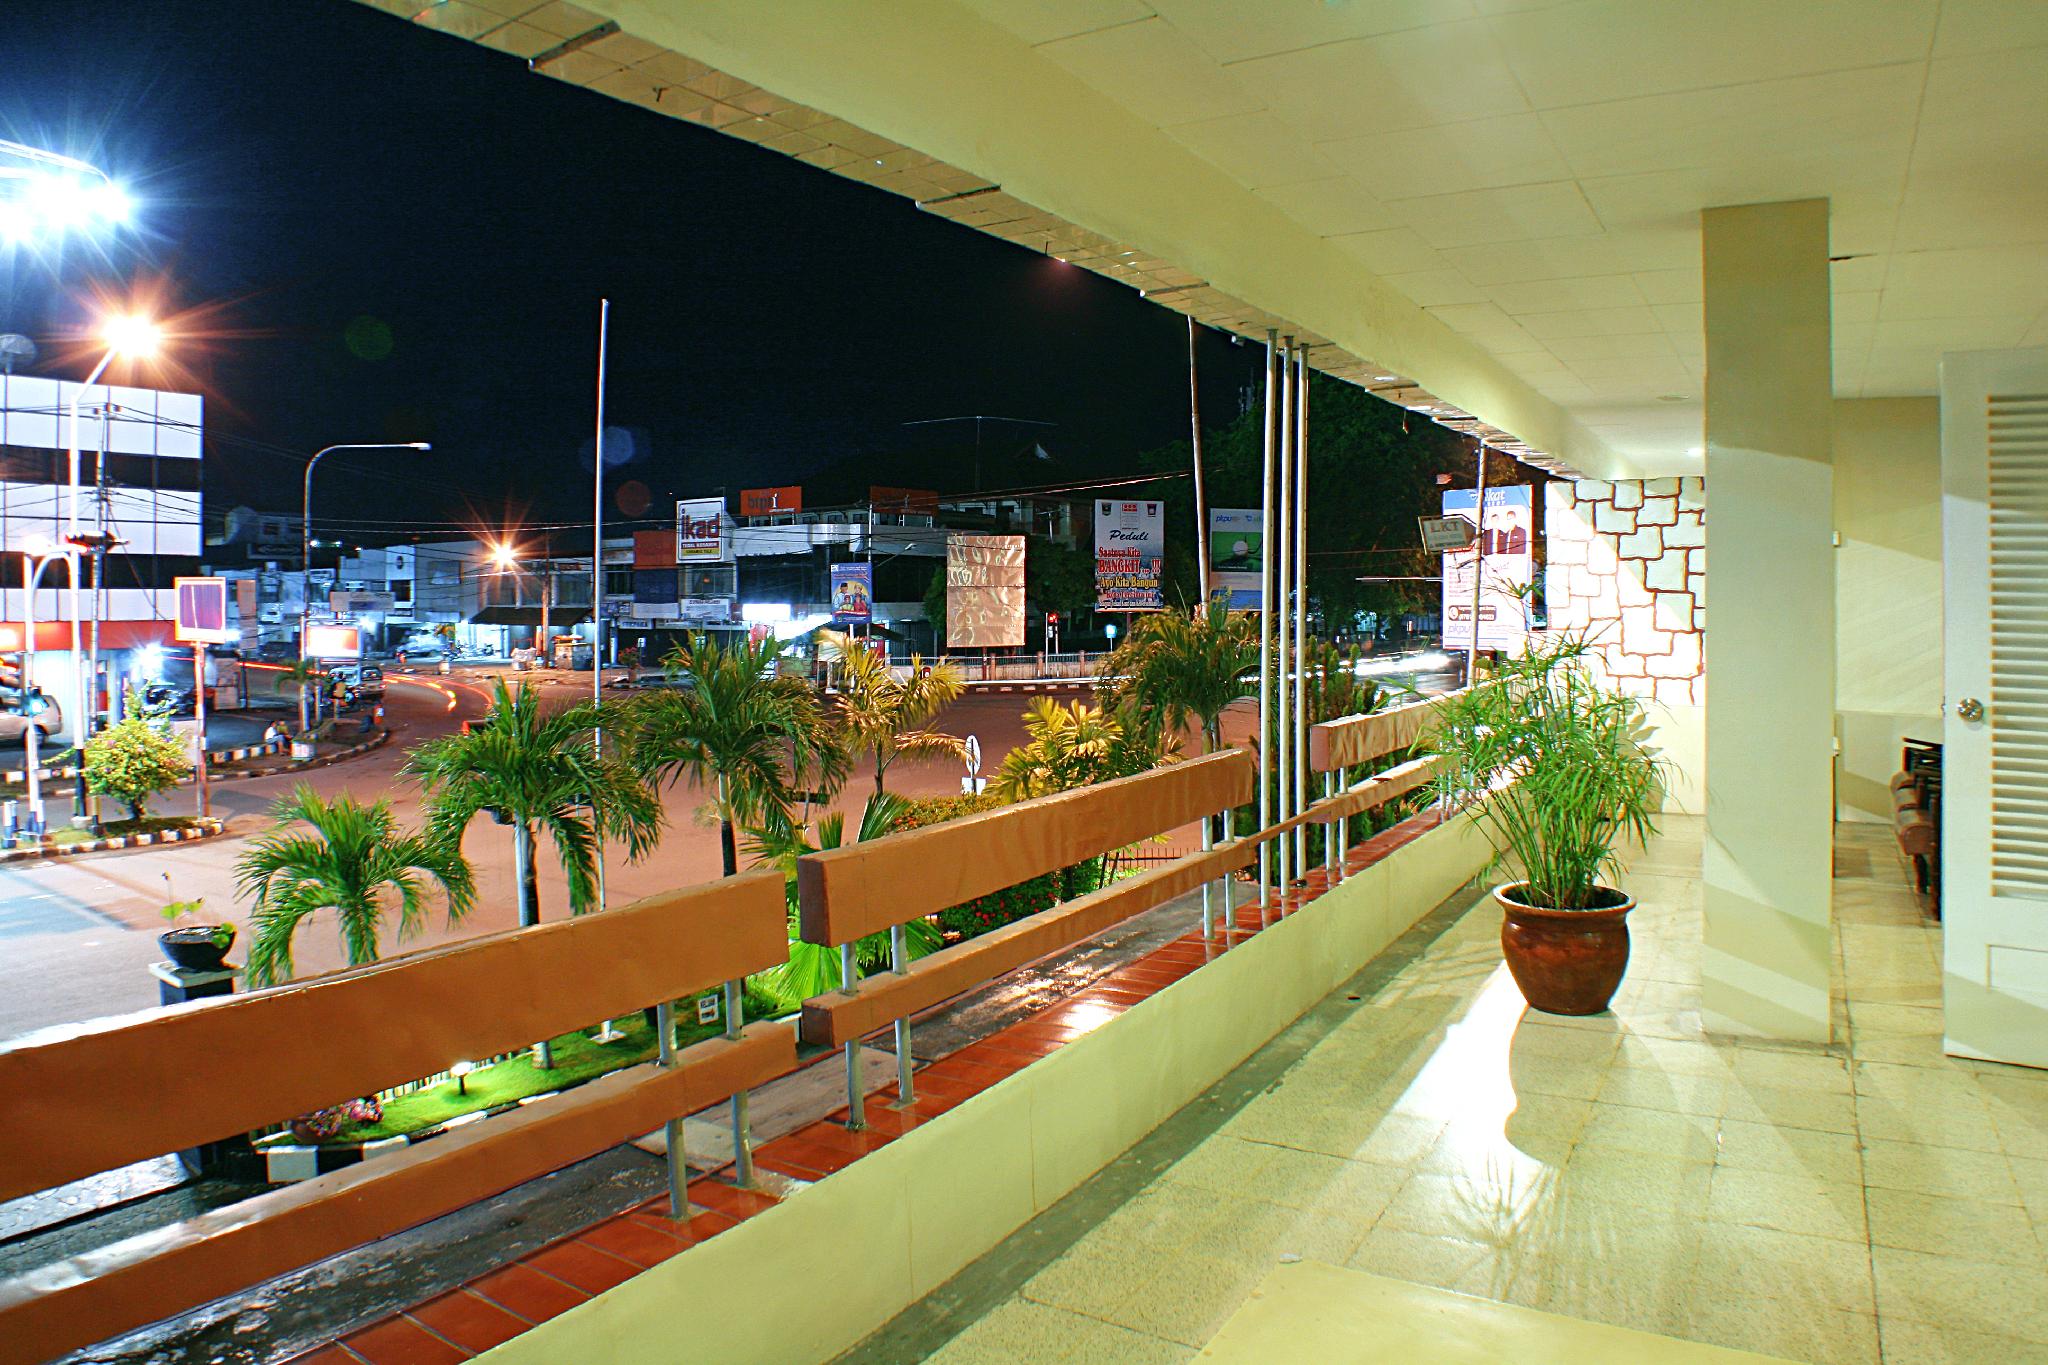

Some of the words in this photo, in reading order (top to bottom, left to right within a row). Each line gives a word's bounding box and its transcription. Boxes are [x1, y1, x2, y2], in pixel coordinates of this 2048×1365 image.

[681, 508, 720, 540] ikad
[1109, 529, 1149, 541] Peduli
[1127, 546, 1141, 557] Kita
[1098, 559, 1140, 573] BANGKIT
[1100, 577, 1115, 589] Ayo
[1115, 577, 1130, 588] Kita
[1131, 576, 1158, 589] Bangun
